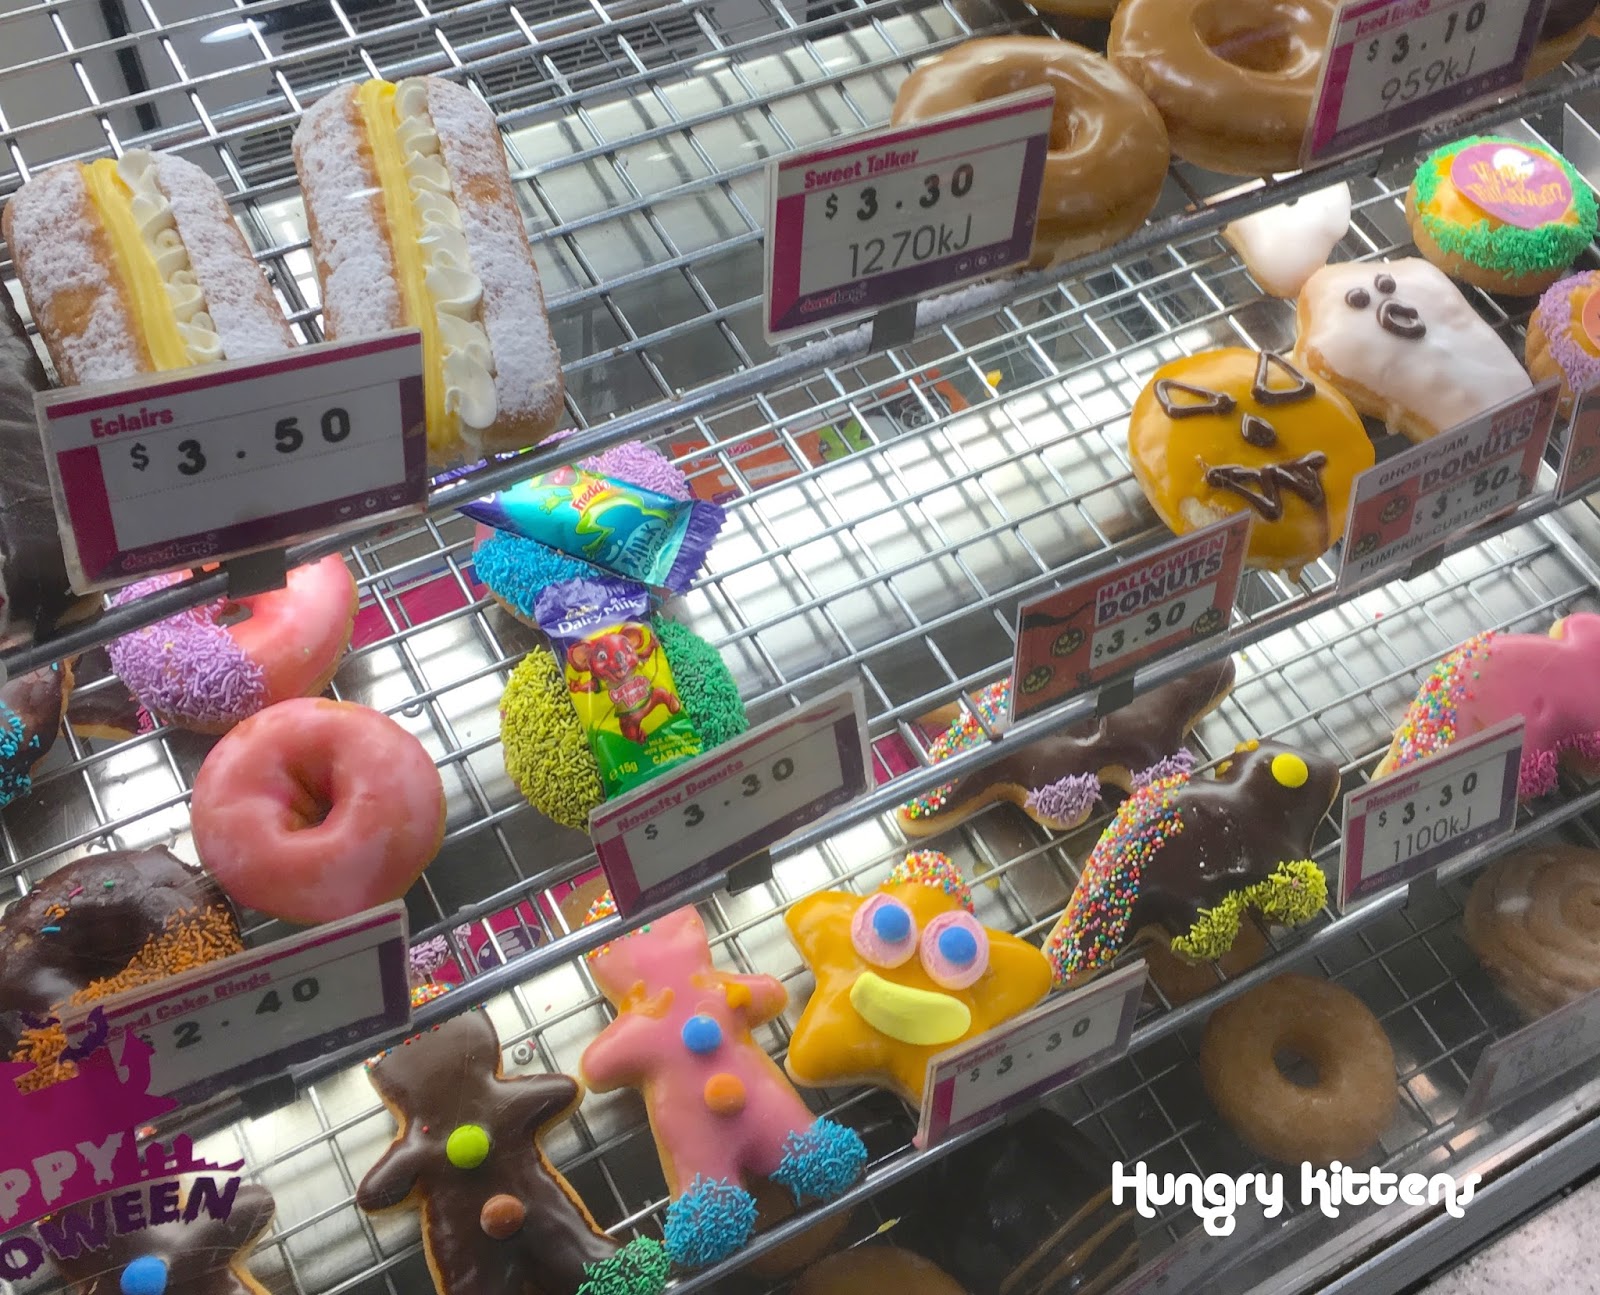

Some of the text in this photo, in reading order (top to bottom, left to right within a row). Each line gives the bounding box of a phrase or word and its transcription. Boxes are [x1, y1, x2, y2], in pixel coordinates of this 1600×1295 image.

[804, 149, 919, 189] Sweet Talker
[849, 213, 972, 278] 1270kJ
[90, 408, 173, 438] Eclairs
[1422, 422, 1532, 489] DONUTS
[571, 479, 611, 511] Freddo
[1099, 551, 1221, 624] DONUTS
[1100, 536, 1224, 601] HALLOWEEN
[558, 613, 602, 635] Dairy
[603, 597, 641, 615] Milk
[617, 760, 743, 832] Novelty Donuts
[1394, 806, 1471, 862] 1100kJ
[109, 971, 271, 1037] ced Cake Rings
